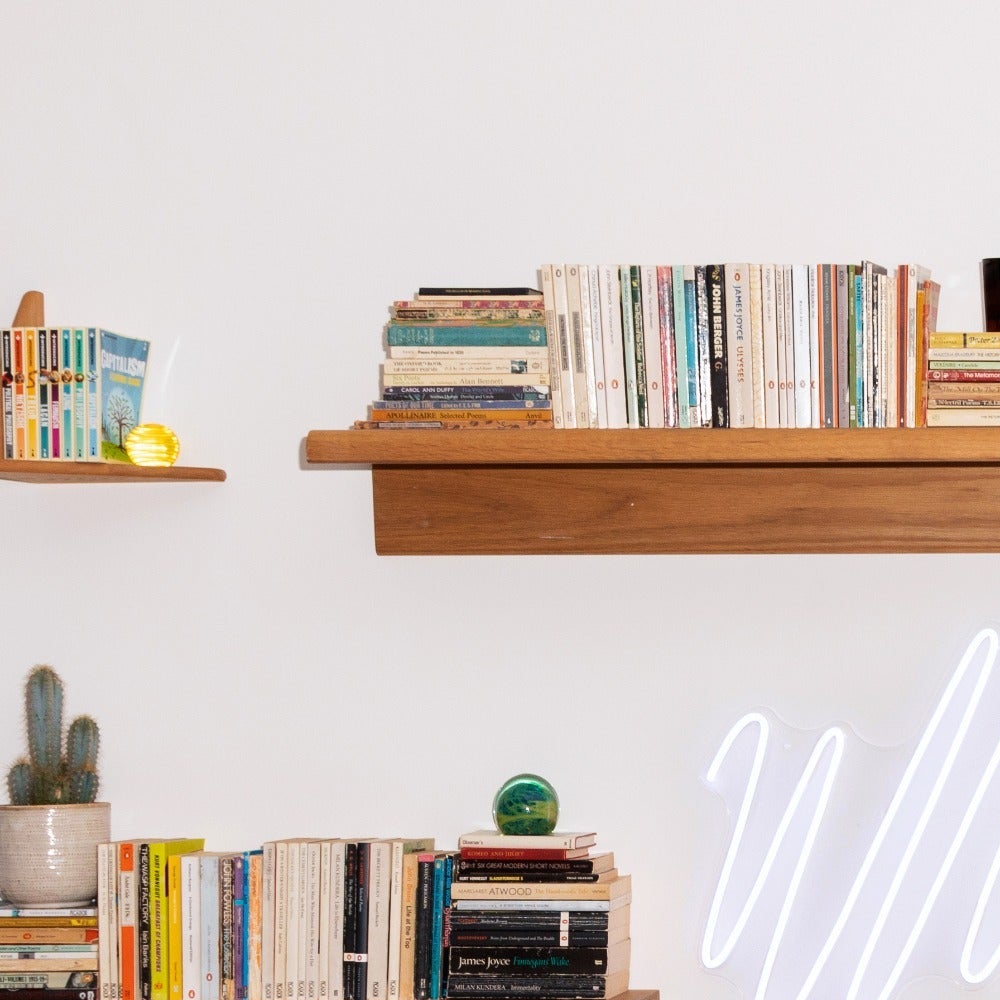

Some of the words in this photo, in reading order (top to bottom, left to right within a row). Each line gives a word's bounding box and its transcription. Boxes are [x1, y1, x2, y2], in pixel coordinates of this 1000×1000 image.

[712, 283, 722, 313] JOHN
[733, 285, 742, 313] JAMES
[713, 315, 723, 359] BERGER
[734, 314, 743, 341] JOYCE
[101, 349, 146, 378] CAPITALISM
[439, 411, 465, 419] Selected
[525, 411, 542, 419] Anvil
[488, 887, 532, 896] ATWOOD
[458, 956, 485, 970] James
[487, 956, 510, 970] Joyce
[550, 956, 570, 967] Wake
[510, 984, 541, 992] Immortality
